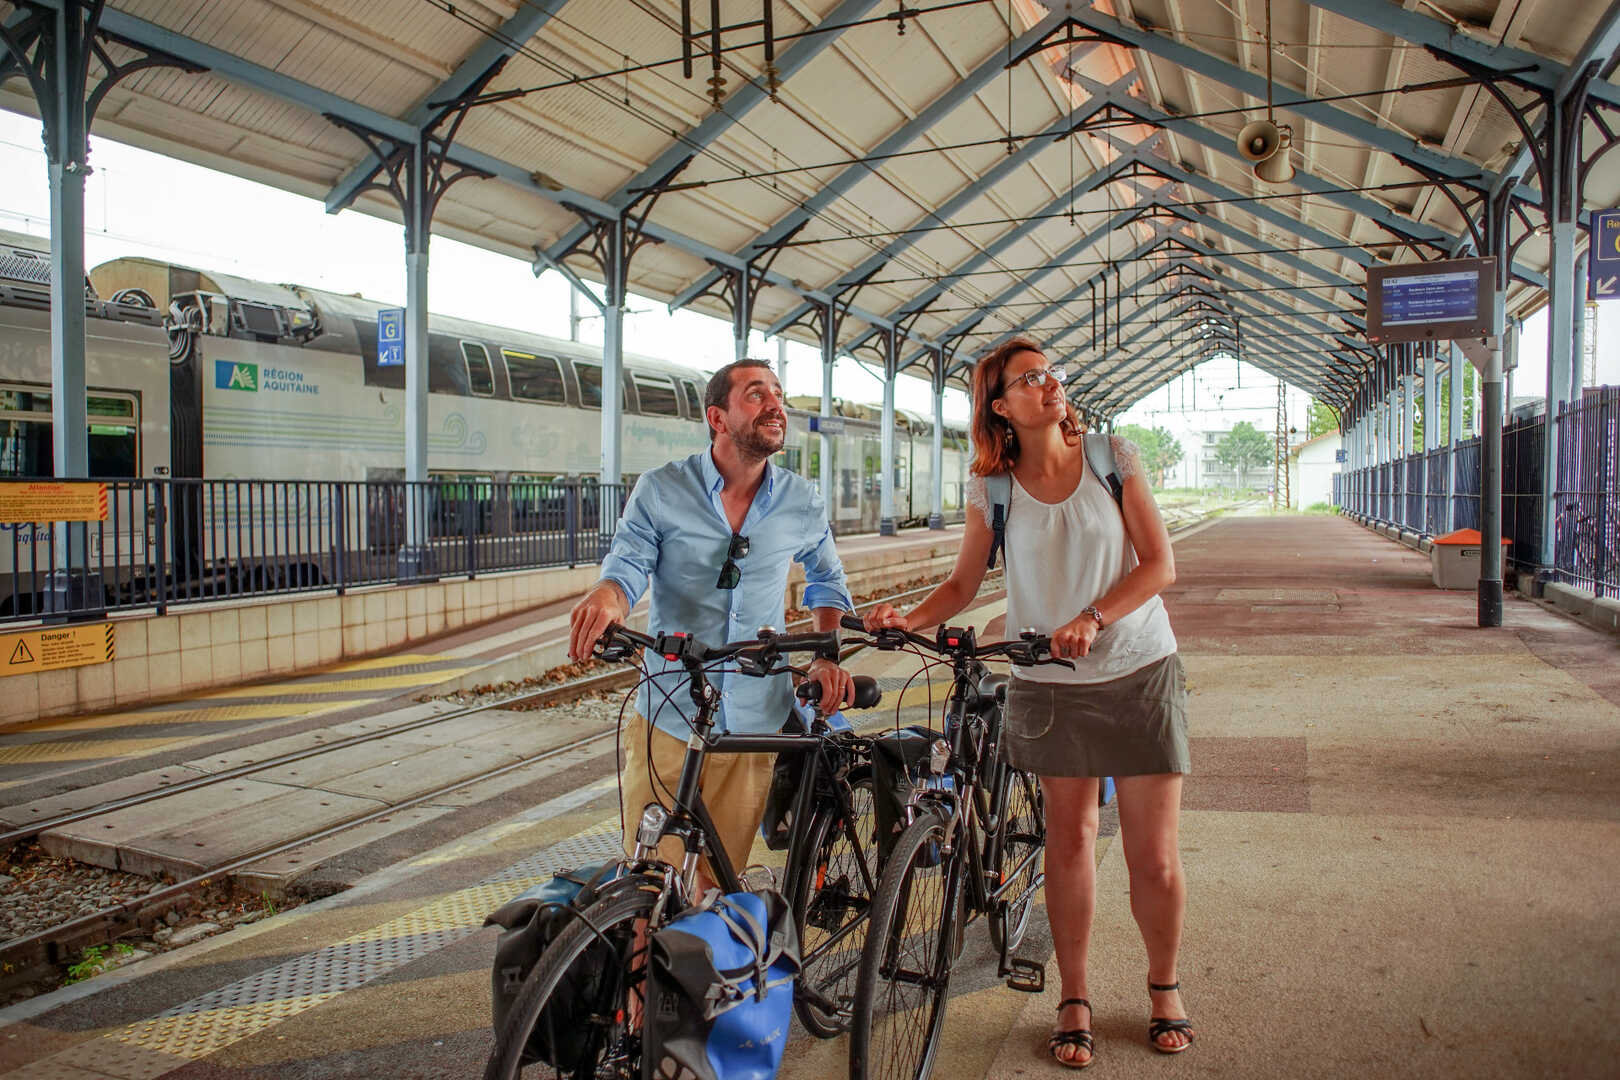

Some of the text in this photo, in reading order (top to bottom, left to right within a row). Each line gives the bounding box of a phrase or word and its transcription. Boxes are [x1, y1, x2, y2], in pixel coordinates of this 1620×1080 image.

[385, 323, 396, 338] G
[263, 367, 303, 382] RÉGION
[263, 380, 320, 395] AQUITAINE
[41, 632, 71, 641] Danger
